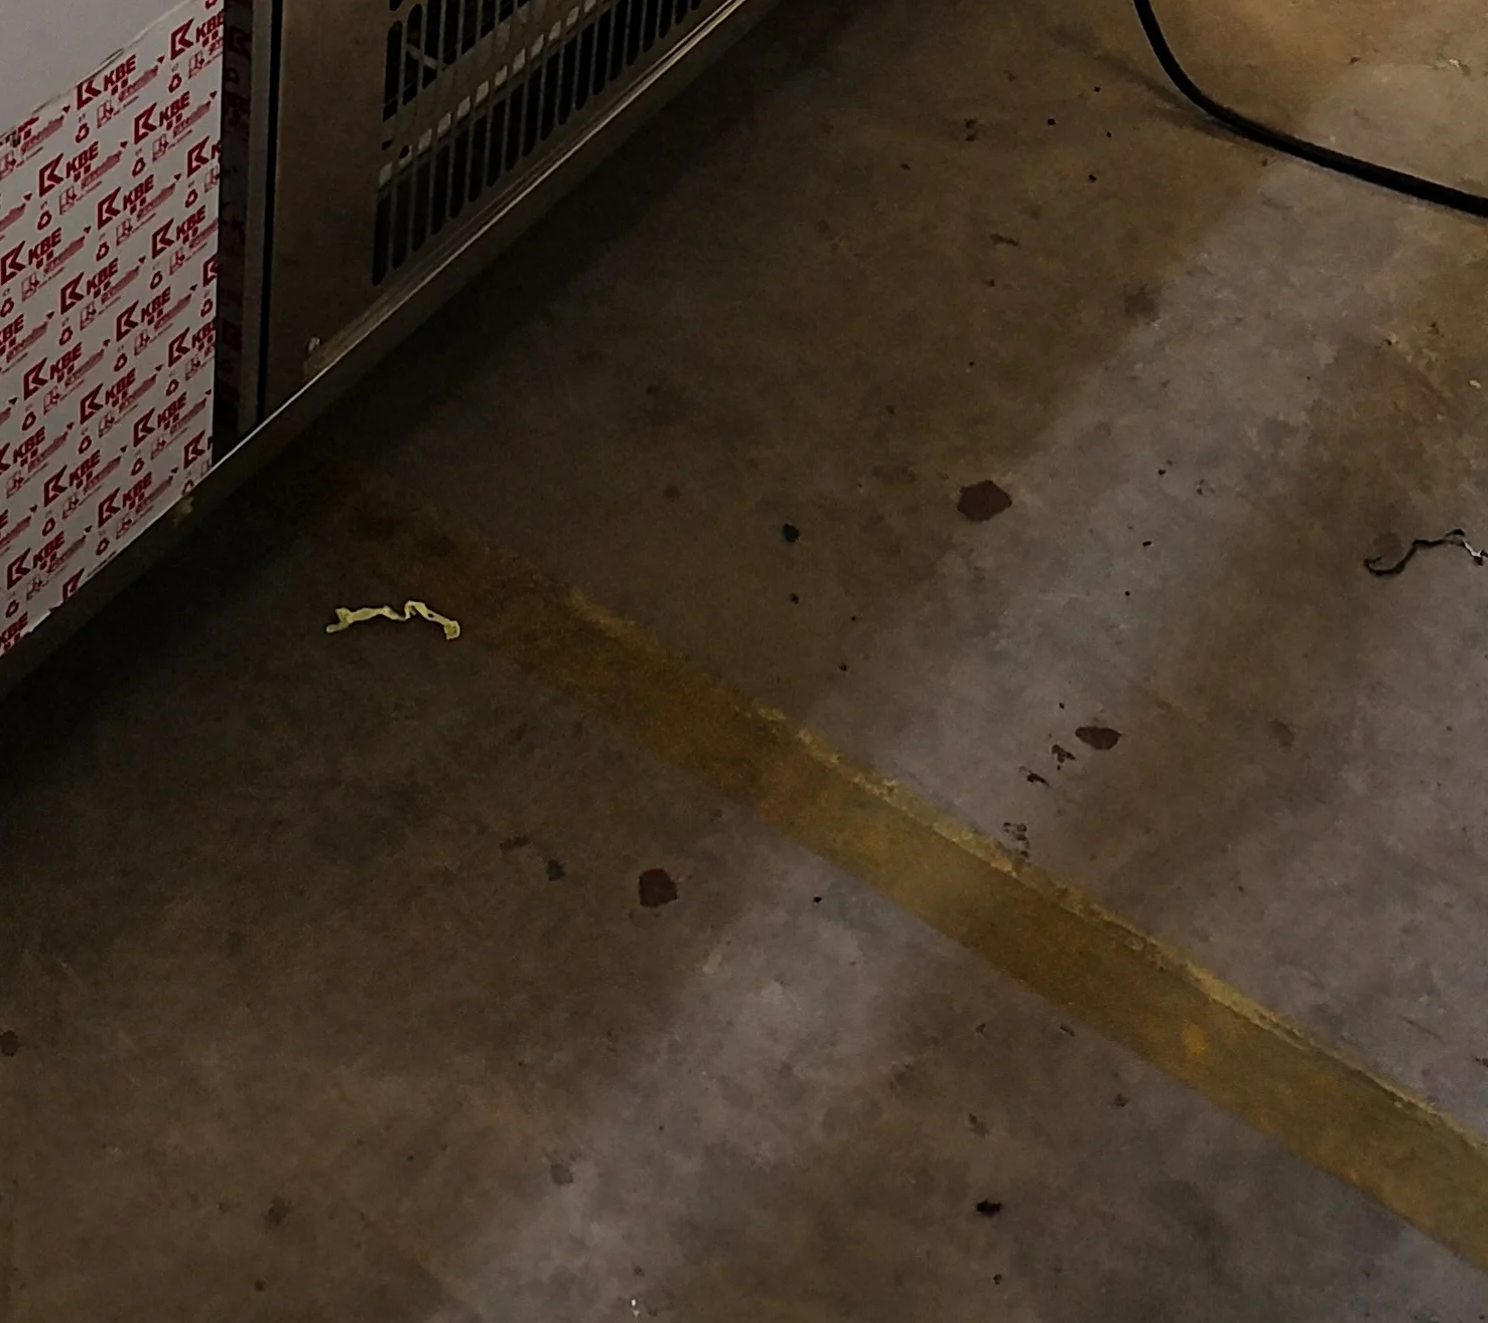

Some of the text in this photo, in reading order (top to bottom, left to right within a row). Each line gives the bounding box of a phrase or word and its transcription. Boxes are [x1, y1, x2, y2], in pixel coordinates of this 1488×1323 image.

[103, 54, 137, 92] KBE
[159, 91, 190, 127] KBE
[66, 141, 99, 179] KBE
[123, 175, 154, 211] KBE
[176, 206, 205, 240] KBE
[28, 227, 62, 265] KBE
[86, 258, 119, 294] KBE
[141, 288, 170, 322] KBE
[192, 321, 214, 348] KB
[50, 343, 81, 379] KBE
[105, 369, 136, 403] KBE
[158, 394, 186, 426] KBE
[13, 427, 46, 463] KBE
[70, 451, 99, 485] KBE
[123, 474, 151, 506] KBE
[33, 533, 64, 567] KBE
